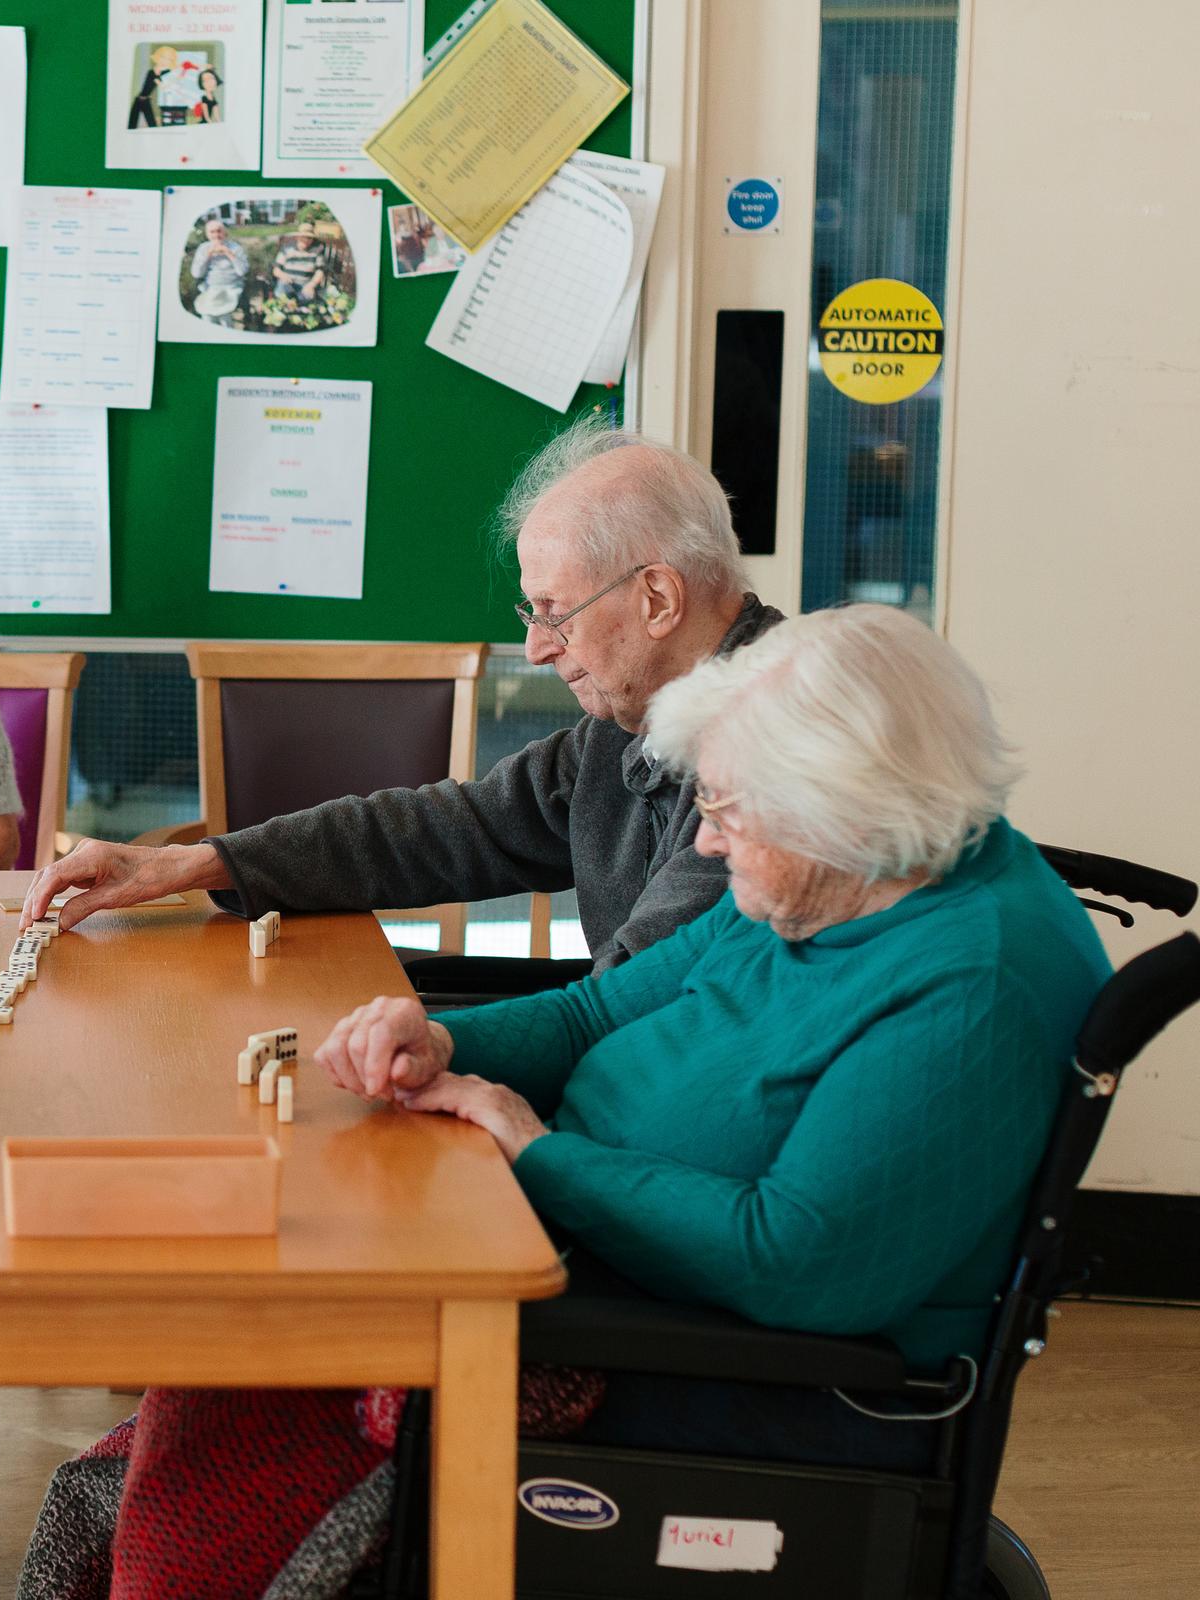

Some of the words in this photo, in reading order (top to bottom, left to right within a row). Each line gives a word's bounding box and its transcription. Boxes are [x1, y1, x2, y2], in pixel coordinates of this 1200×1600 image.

[830, 308, 931, 322] AUTOMATIC
[824, 330, 937, 352] CAUTION
[852, 363, 904, 376] DOOR
